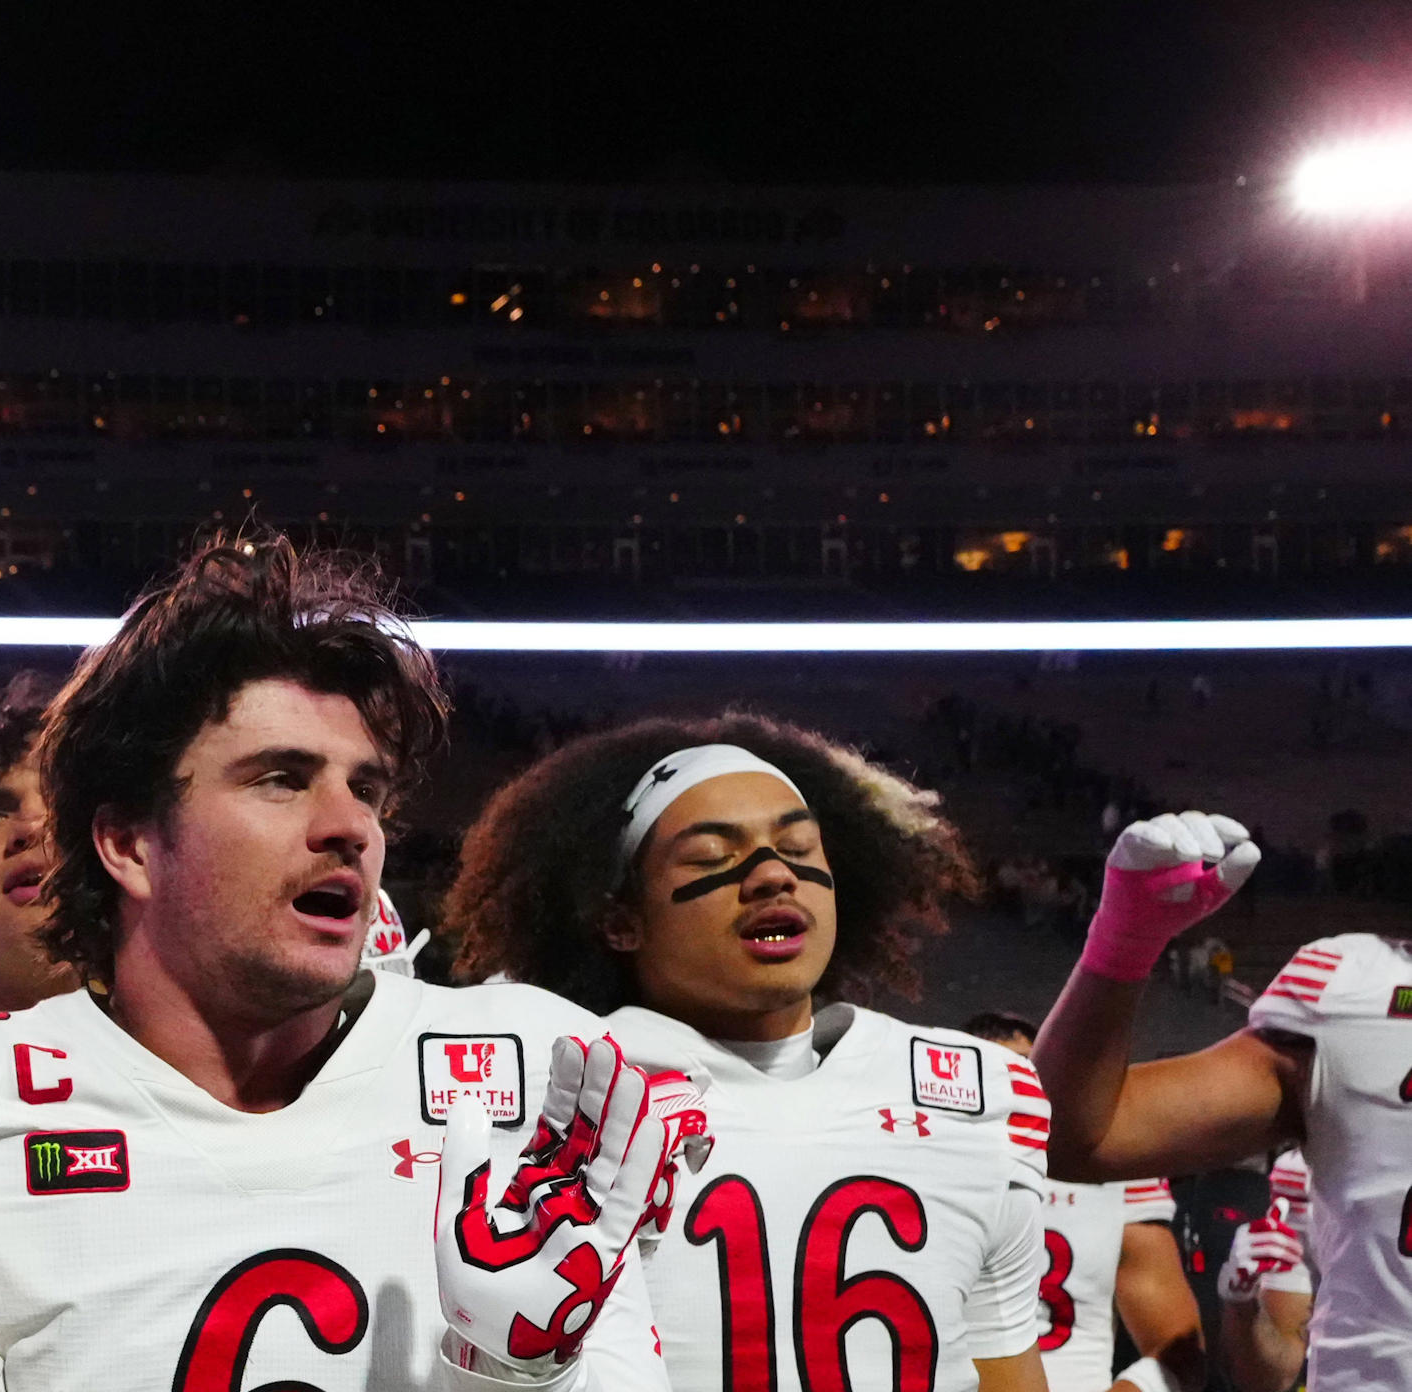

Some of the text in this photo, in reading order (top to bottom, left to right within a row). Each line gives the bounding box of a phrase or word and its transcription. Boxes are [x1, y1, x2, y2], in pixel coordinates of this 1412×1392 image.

[13, 1043, 73, 1105] C
[919, 1081, 976, 1100] HEALTH
[67, 1146, 119, 1172] XII
